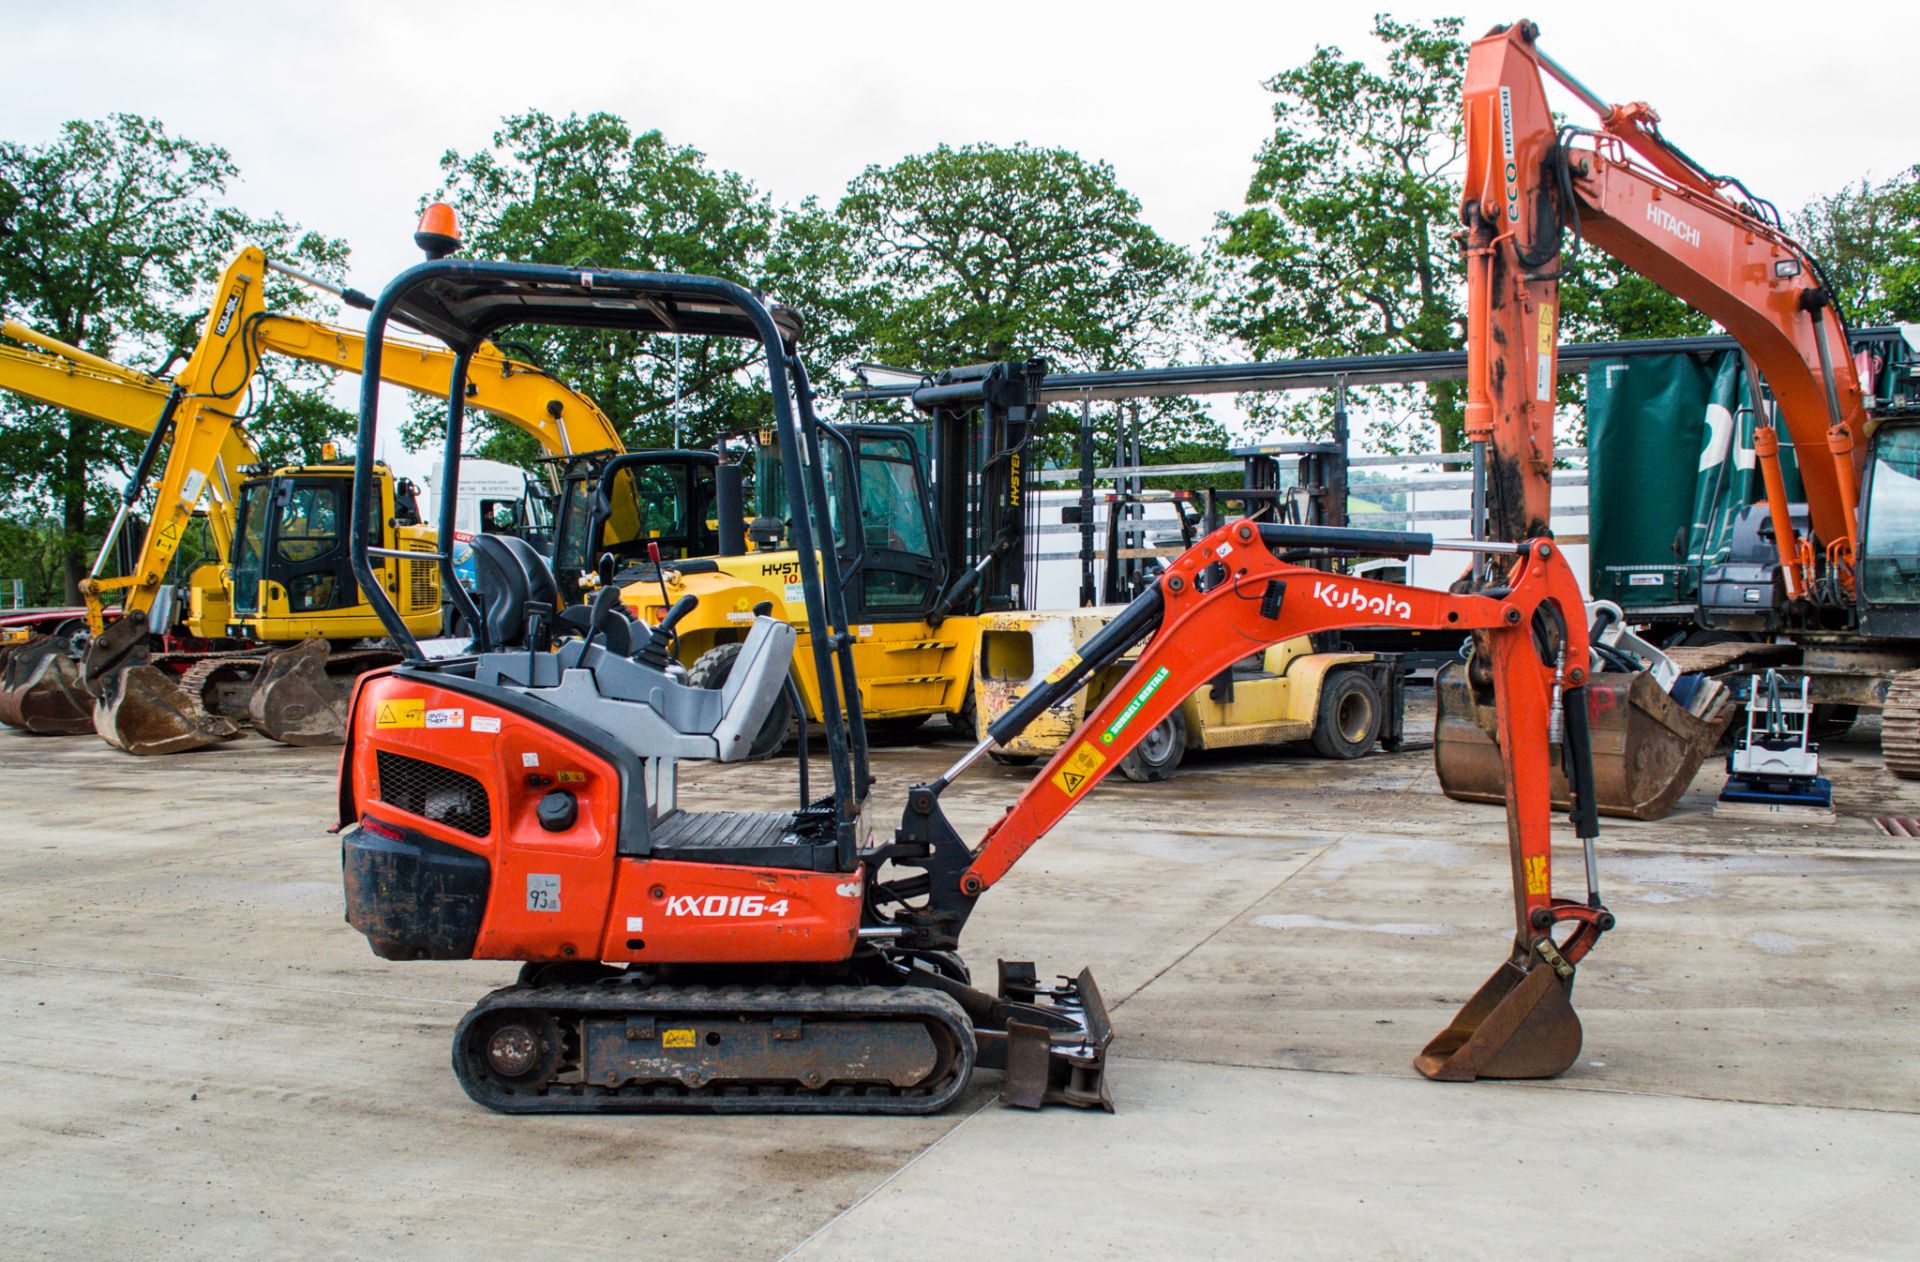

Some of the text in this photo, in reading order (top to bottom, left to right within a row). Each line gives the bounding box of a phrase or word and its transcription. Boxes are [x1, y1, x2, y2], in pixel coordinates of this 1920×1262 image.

[1502, 91, 1512, 154] HITACHI
[1647, 203, 1700, 248] HITACHI
[762, 562, 800, 576] HYST
[1313, 581, 1412, 619] Kubota
[1110, 699, 1141, 734] SUNBELT
[1138, 667, 1169, 702] RENTALS
[530, 889, 548, 909] 93
[665, 895, 789, 917] KX016-4
